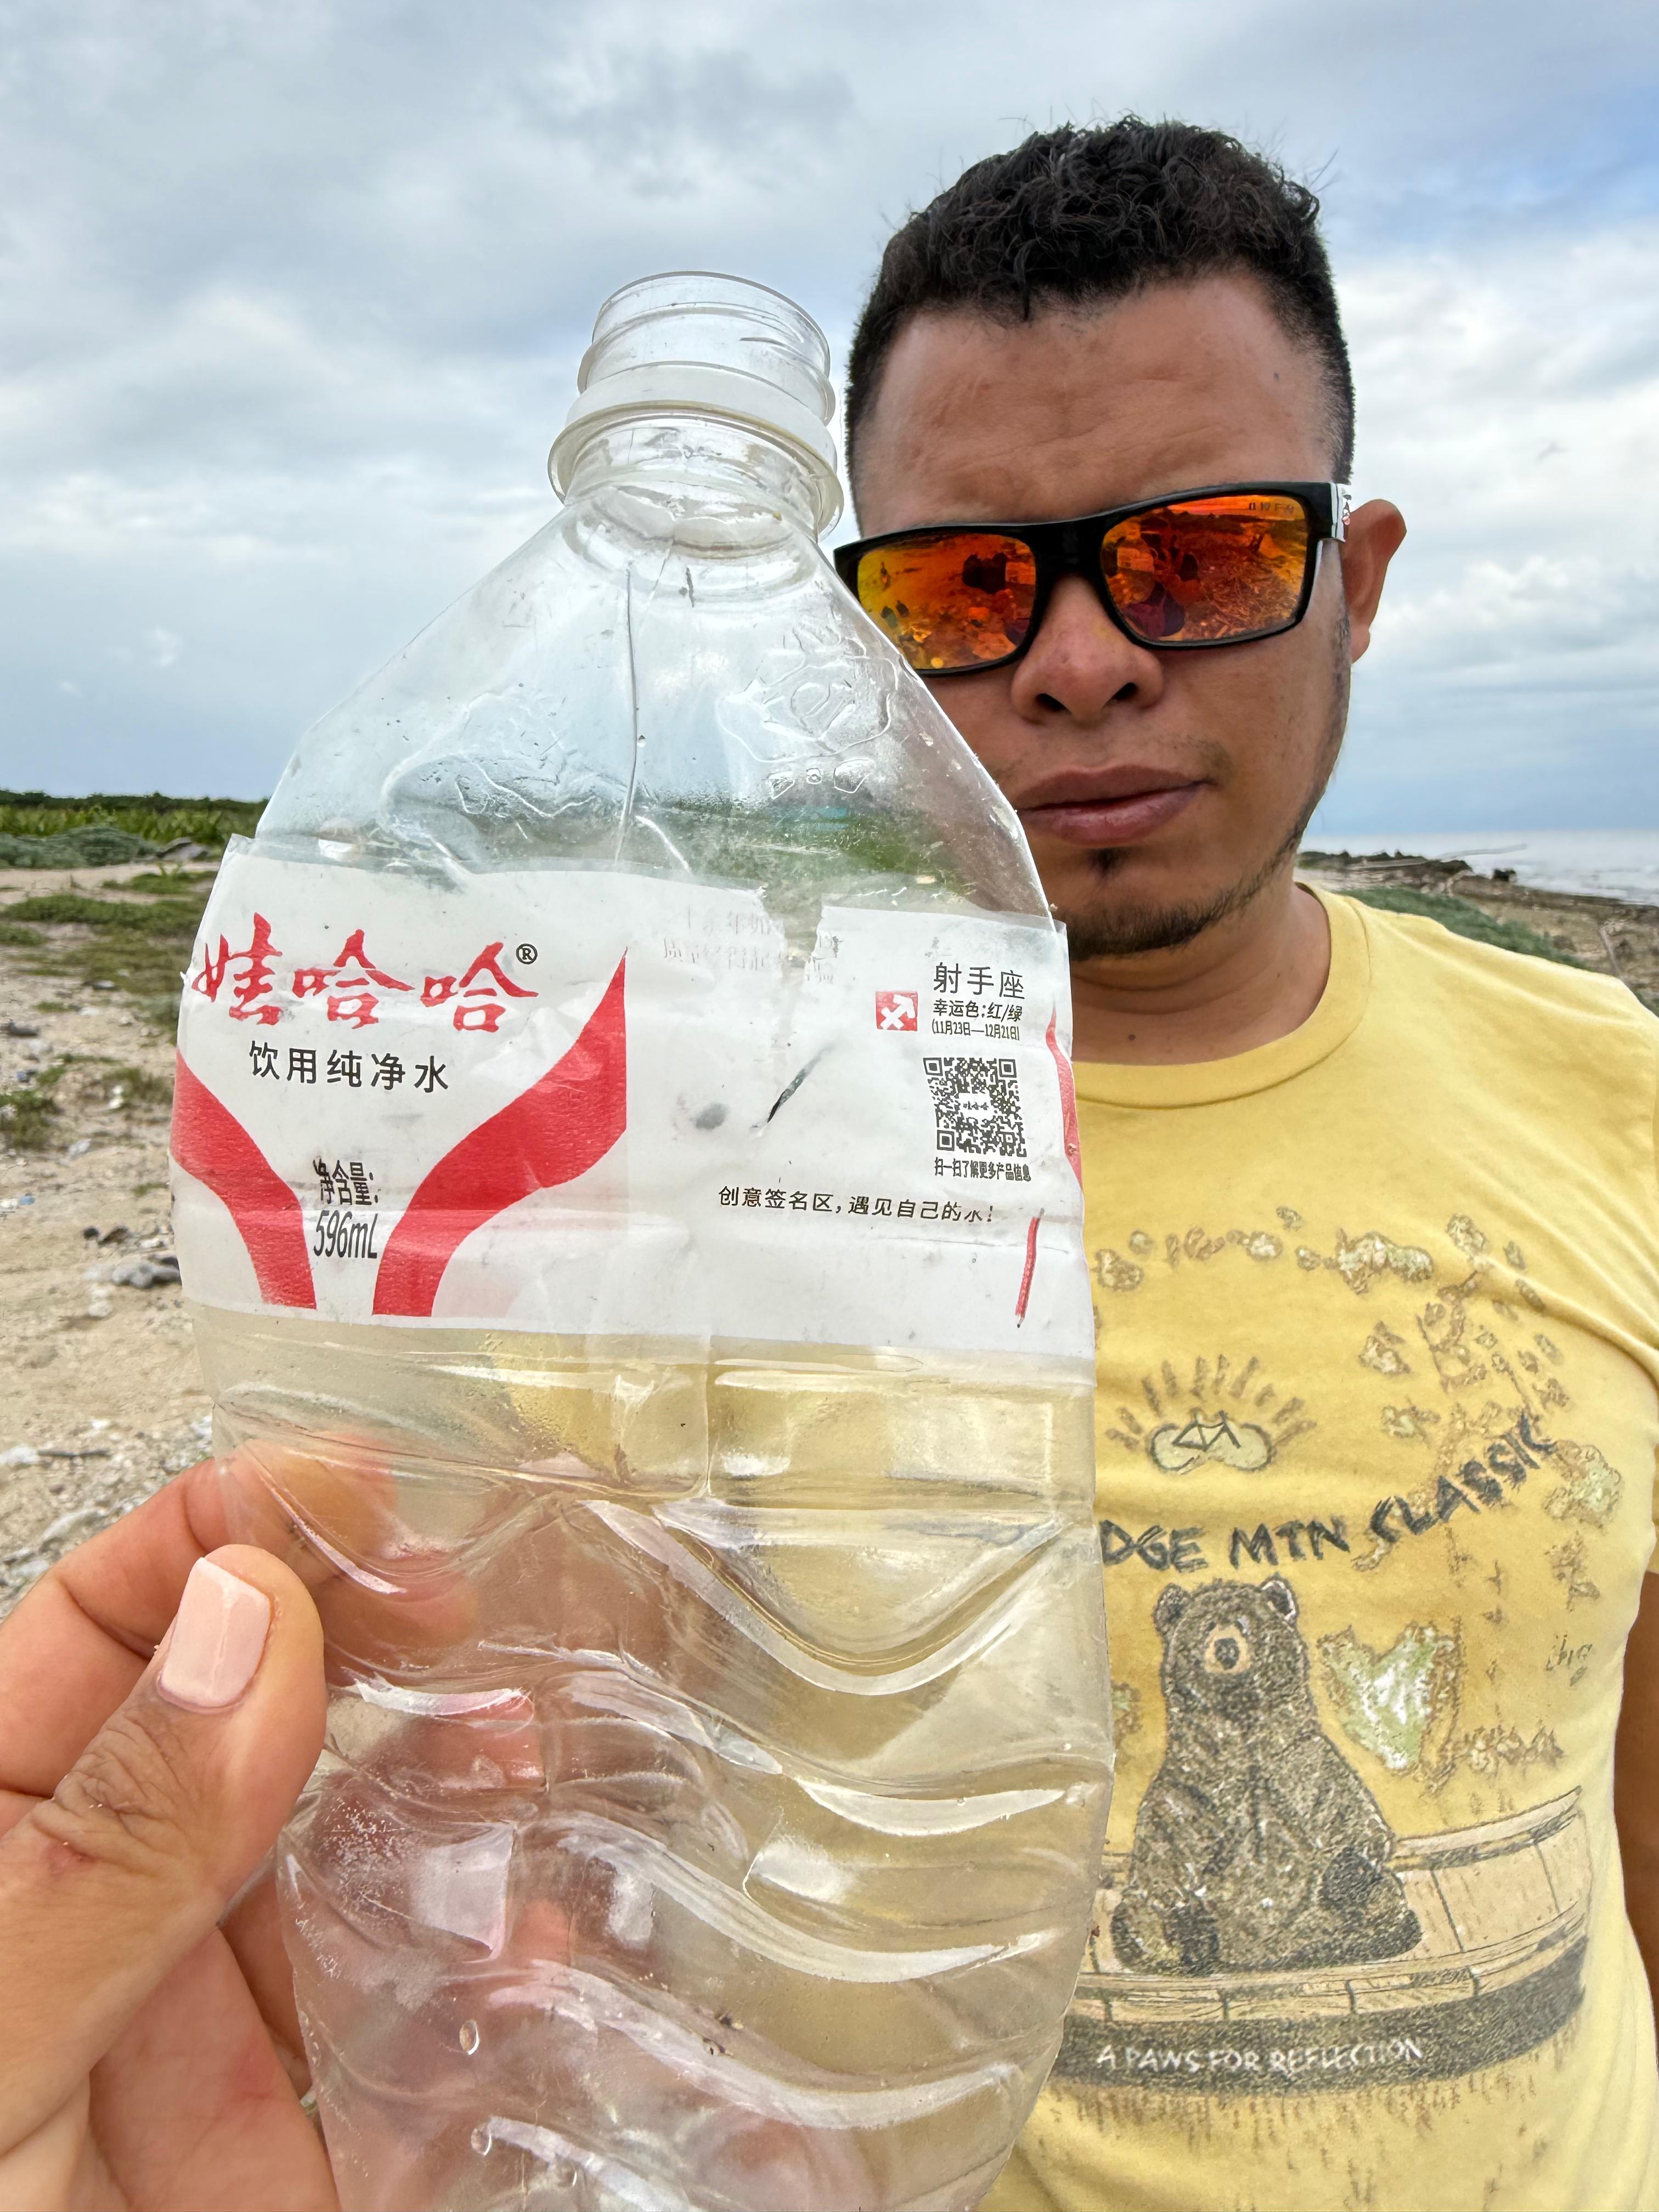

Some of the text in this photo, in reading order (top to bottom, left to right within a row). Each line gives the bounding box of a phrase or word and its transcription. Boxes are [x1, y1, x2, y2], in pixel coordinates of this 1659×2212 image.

[933, 962, 1025, 1000] 射手座
[933, 998, 1023, 1023] 幸运色：红/绿
[249, 1040, 449, 1093] 饮用纯净水
[313, 1209, 379, 1259] 596mL
[1098, 1519, 1209, 1573] DGE
[1228, 1515, 1351, 1571] MTN
[1097, 2037, 1423, 2078] A PAWS FOR REFLECTION
